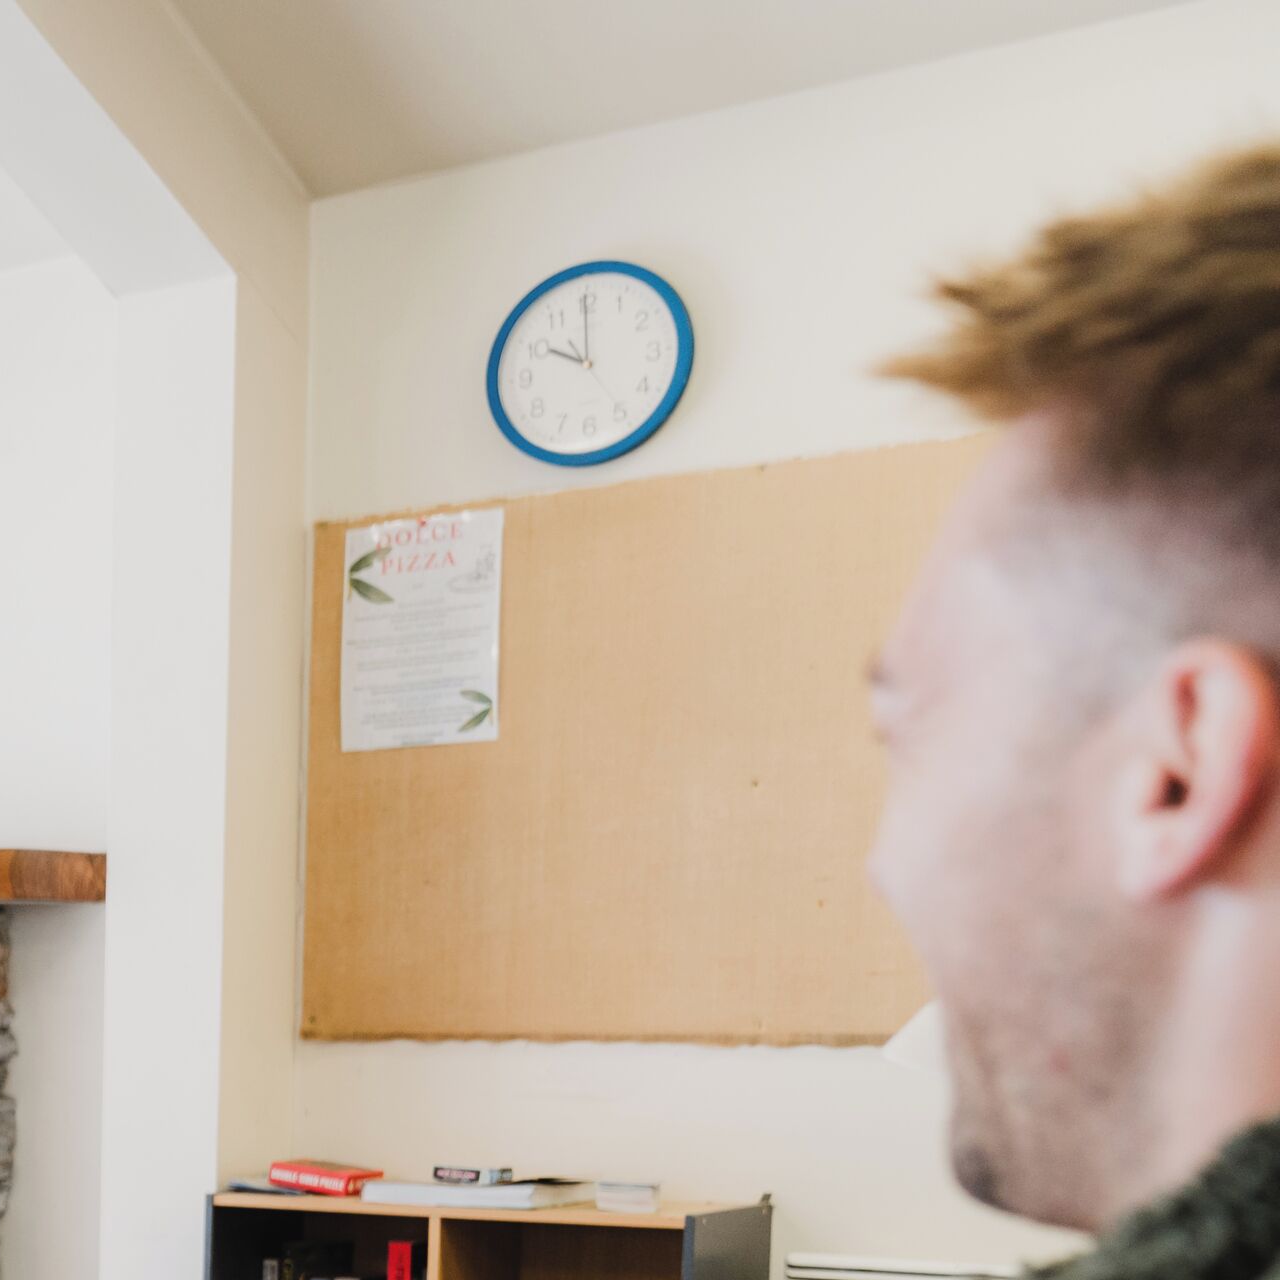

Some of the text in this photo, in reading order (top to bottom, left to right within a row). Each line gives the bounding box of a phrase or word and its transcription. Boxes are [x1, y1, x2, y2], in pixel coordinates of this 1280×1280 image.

[548, 310, 565, 331] 11
[634, 310, 650, 333] 2
[528, 338, 549, 360] 10
[645, 341, 662, 363] 3
[518, 368, 533, 390] 9
[635, 376, 649, 394] 4
[530, 398, 545, 419] 8
[612, 401, 628, 423] 5
[556, 411, 568, 433] 7
[582, 416, 597, 437] 6
[376, 521, 464, 552] DOLCE
[380, 551, 458, 576] PIZZA
